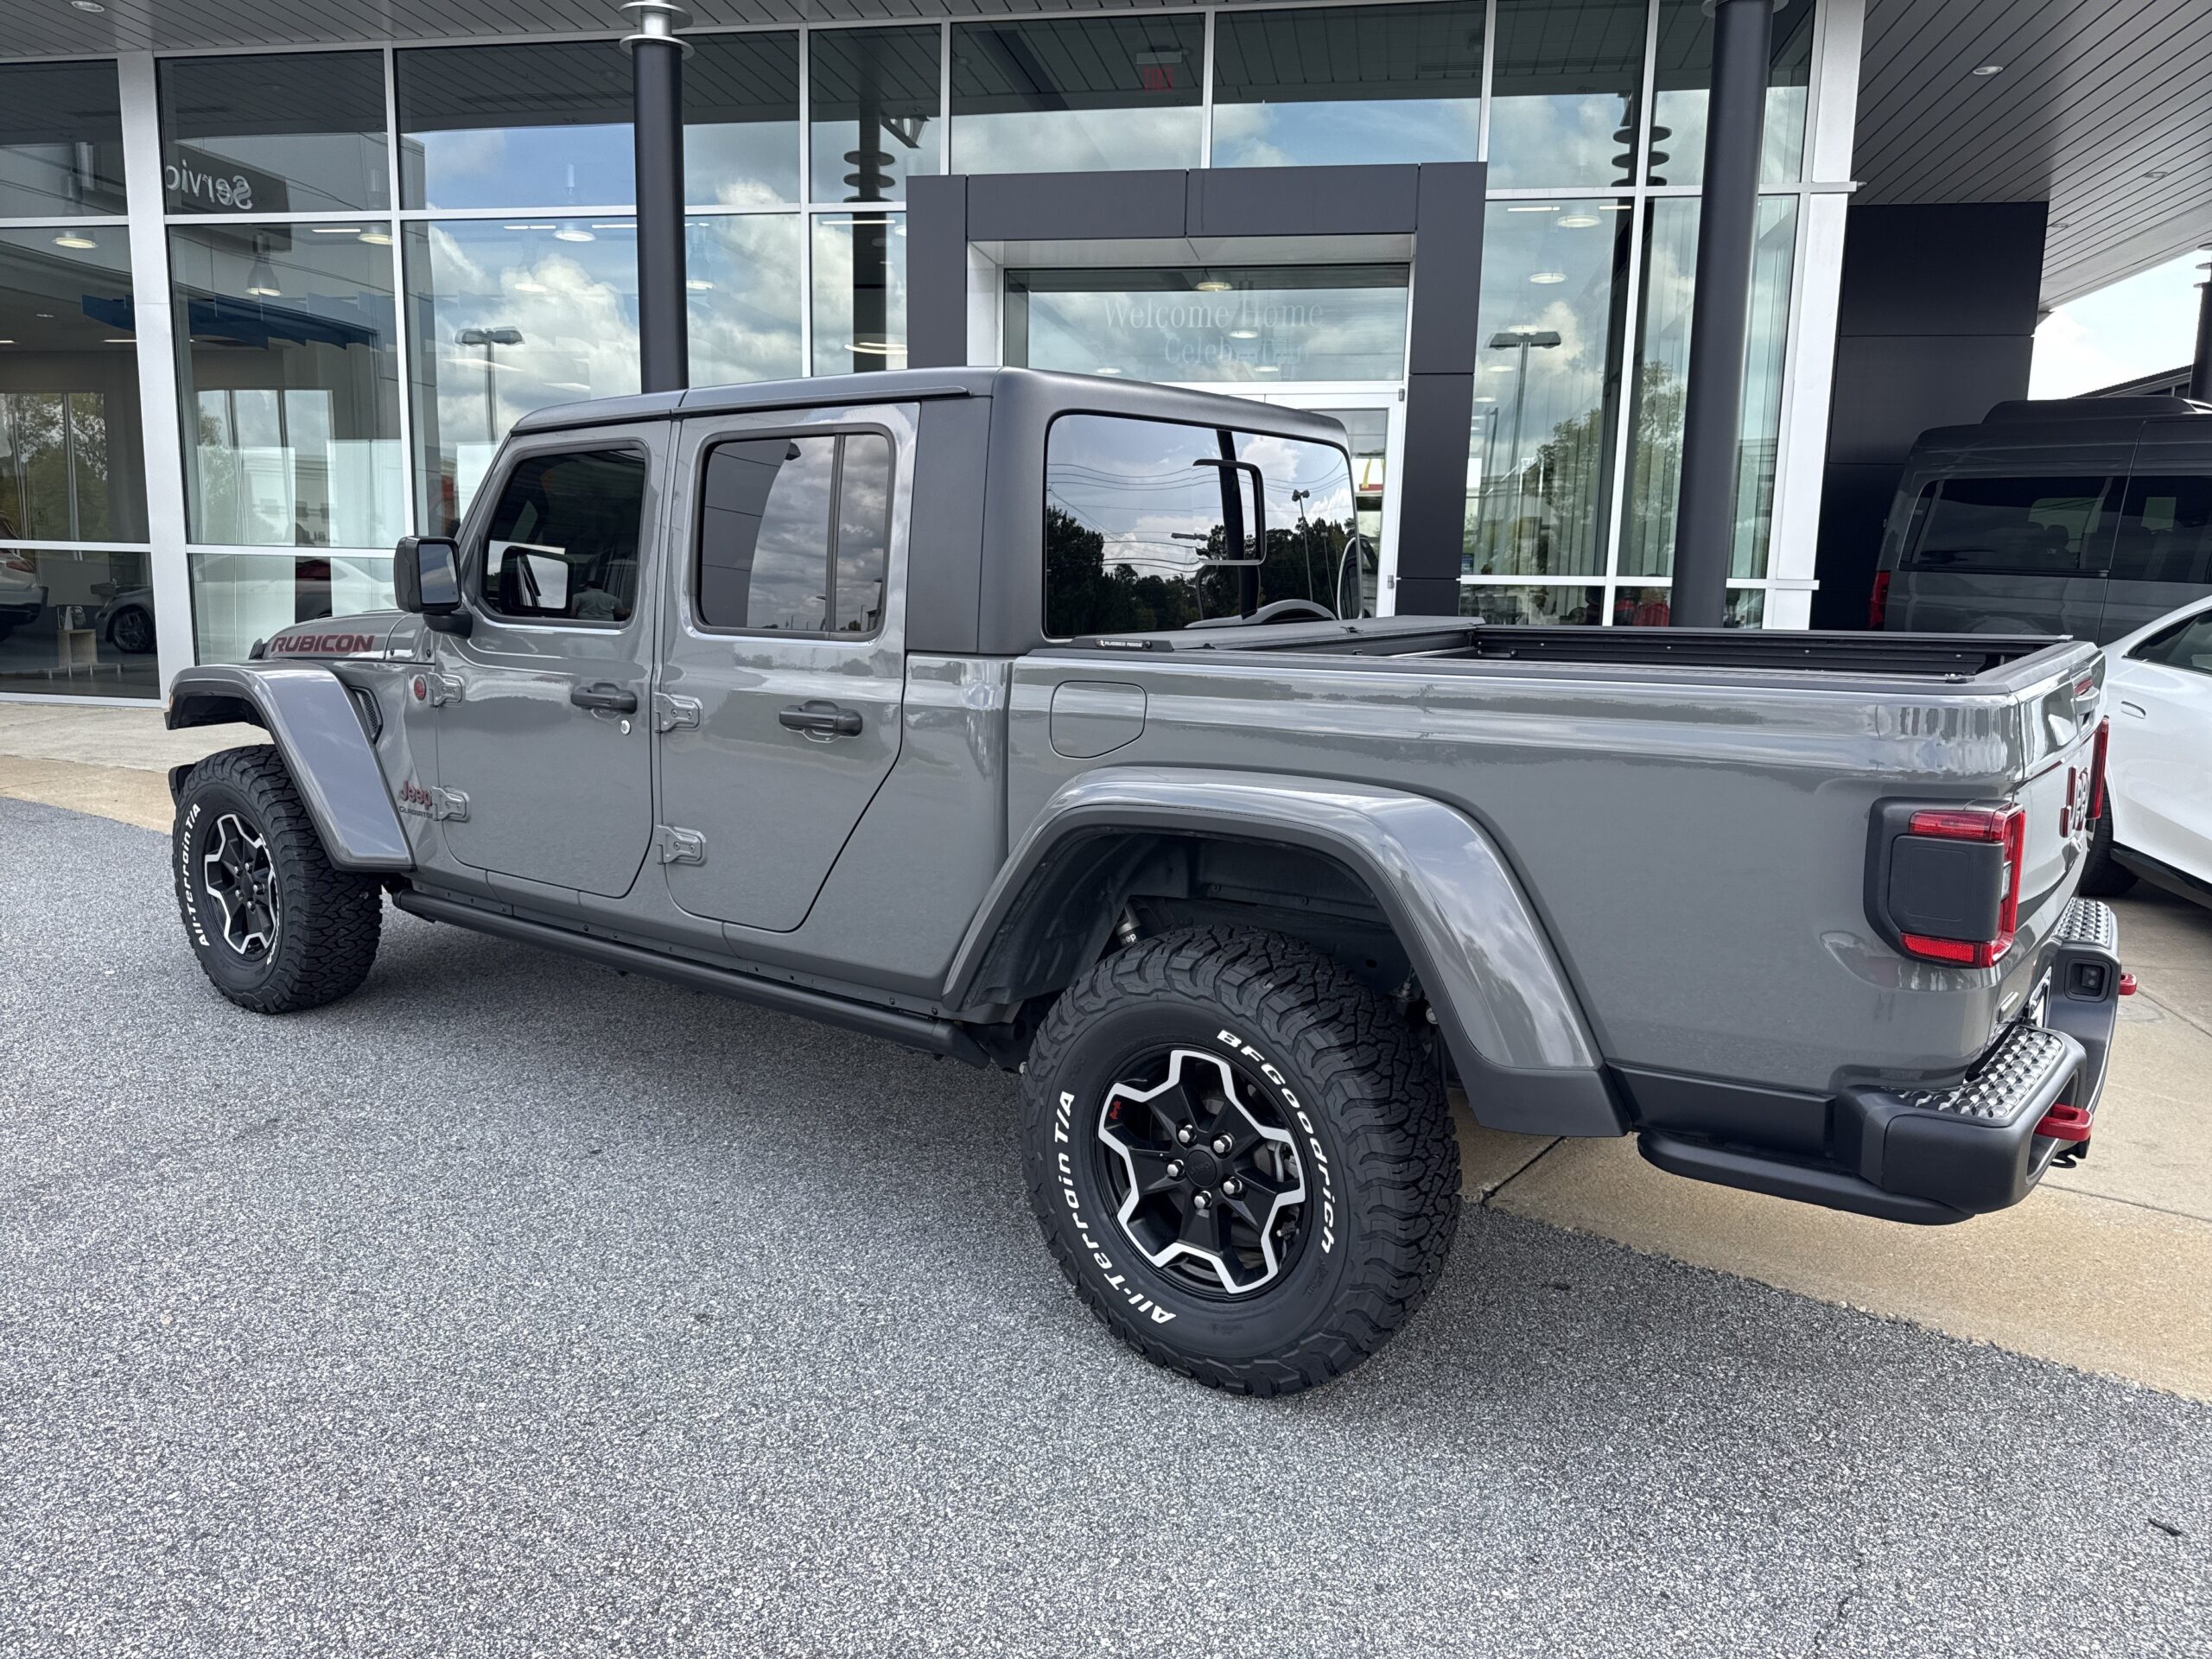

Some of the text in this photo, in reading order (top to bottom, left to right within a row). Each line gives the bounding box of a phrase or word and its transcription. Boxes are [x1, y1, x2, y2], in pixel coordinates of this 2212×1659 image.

[1103, 297, 1324, 328] Welcome Home
[1163, 337, 1309, 365] Celebtn
[270, 633, 375, 652] RUBICON
[400, 779, 432, 810] Jeep
[2059, 766, 2089, 838] Jee
[398, 805, 434, 819] GLADIATO
[182, 803, 210, 947] All-Terrain T/A
[1217, 1029, 1335, 1254] BFGoodrich
[1054, 1090, 1177, 1324] All-Terrain T/A
